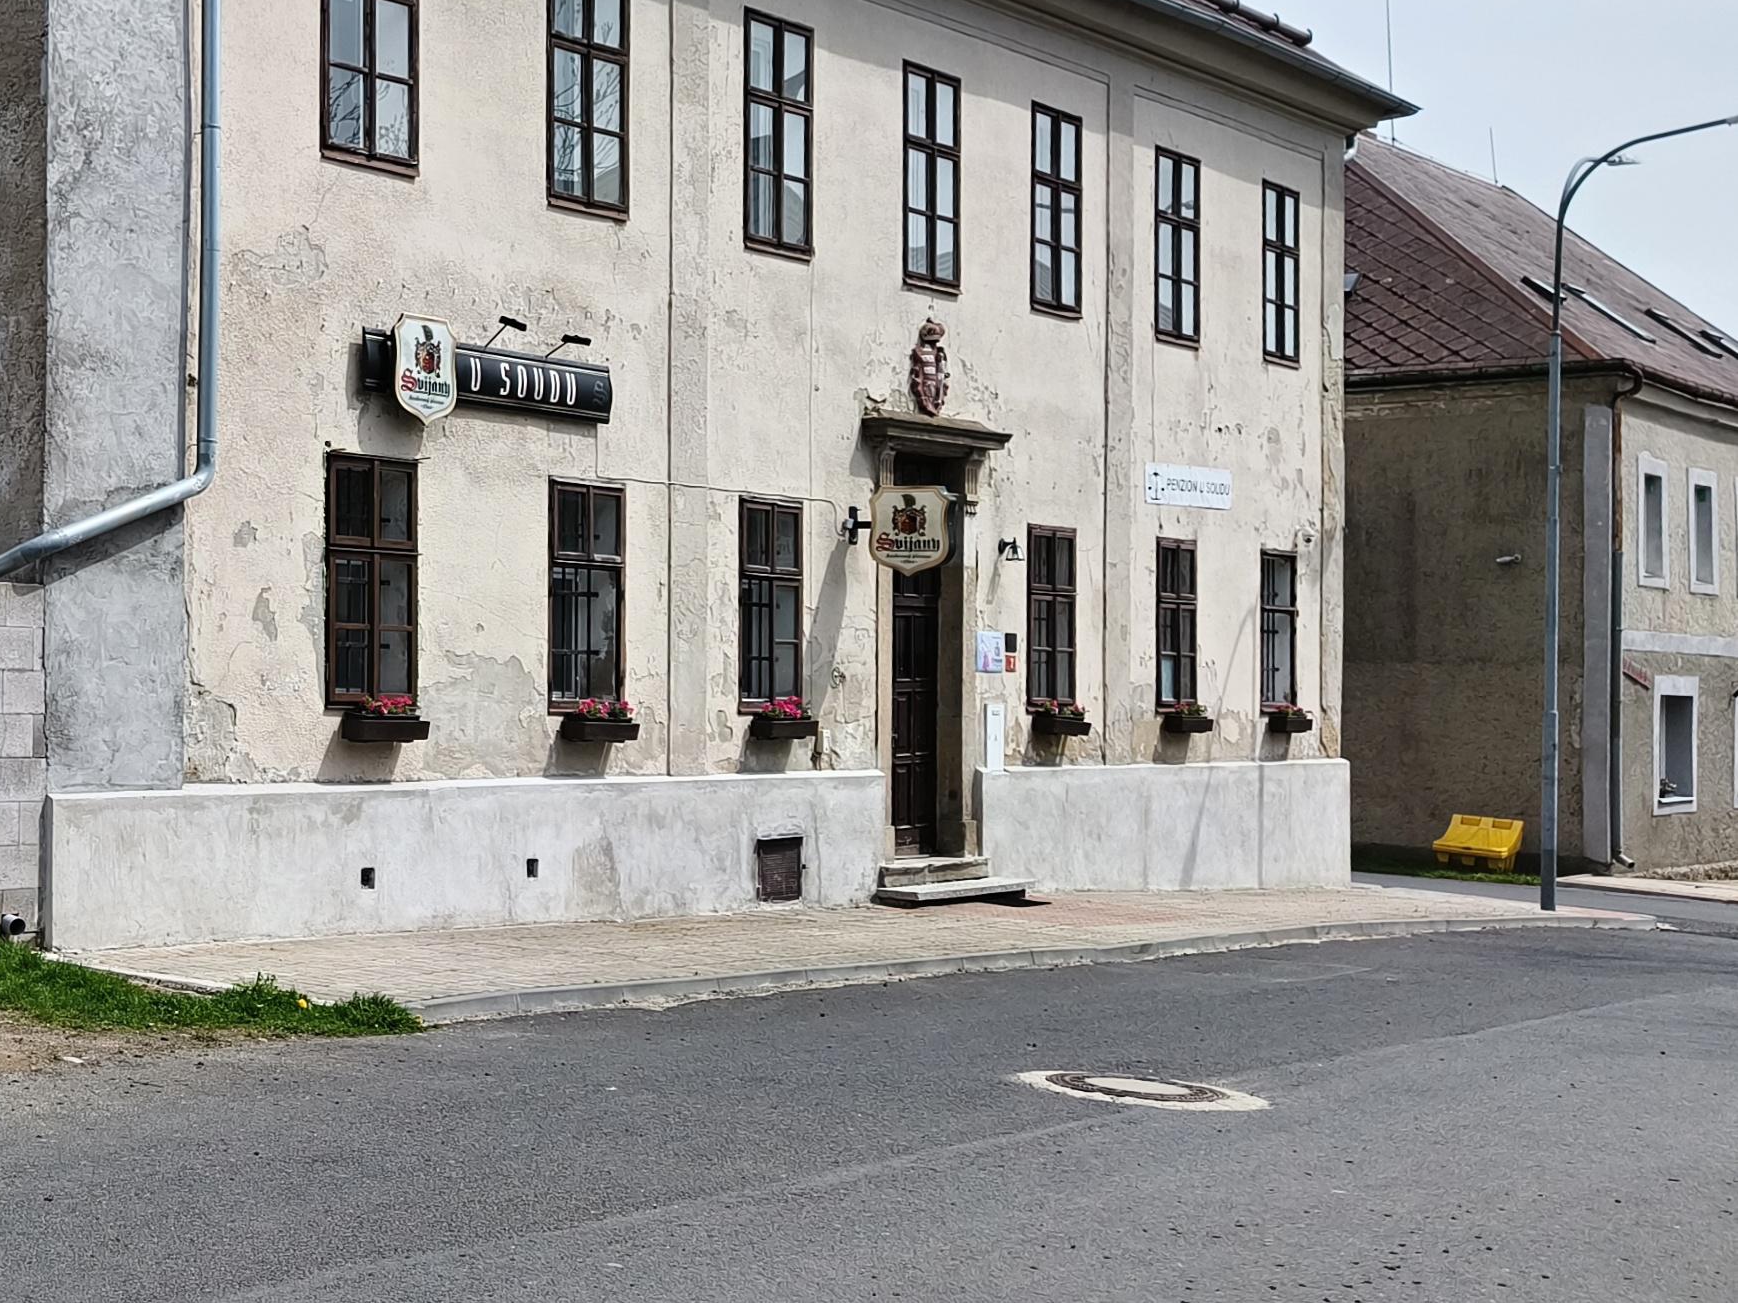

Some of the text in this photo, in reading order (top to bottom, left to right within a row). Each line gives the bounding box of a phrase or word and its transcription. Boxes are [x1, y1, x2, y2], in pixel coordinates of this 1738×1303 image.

[401, 368, 451, 398] Svijany
[470, 357, 577, 406] U SOUDU
[1166, 478, 1198, 493] PENZION
[1206, 482, 1231, 496] SOUDU
[875, 532, 941, 553] Svijany
